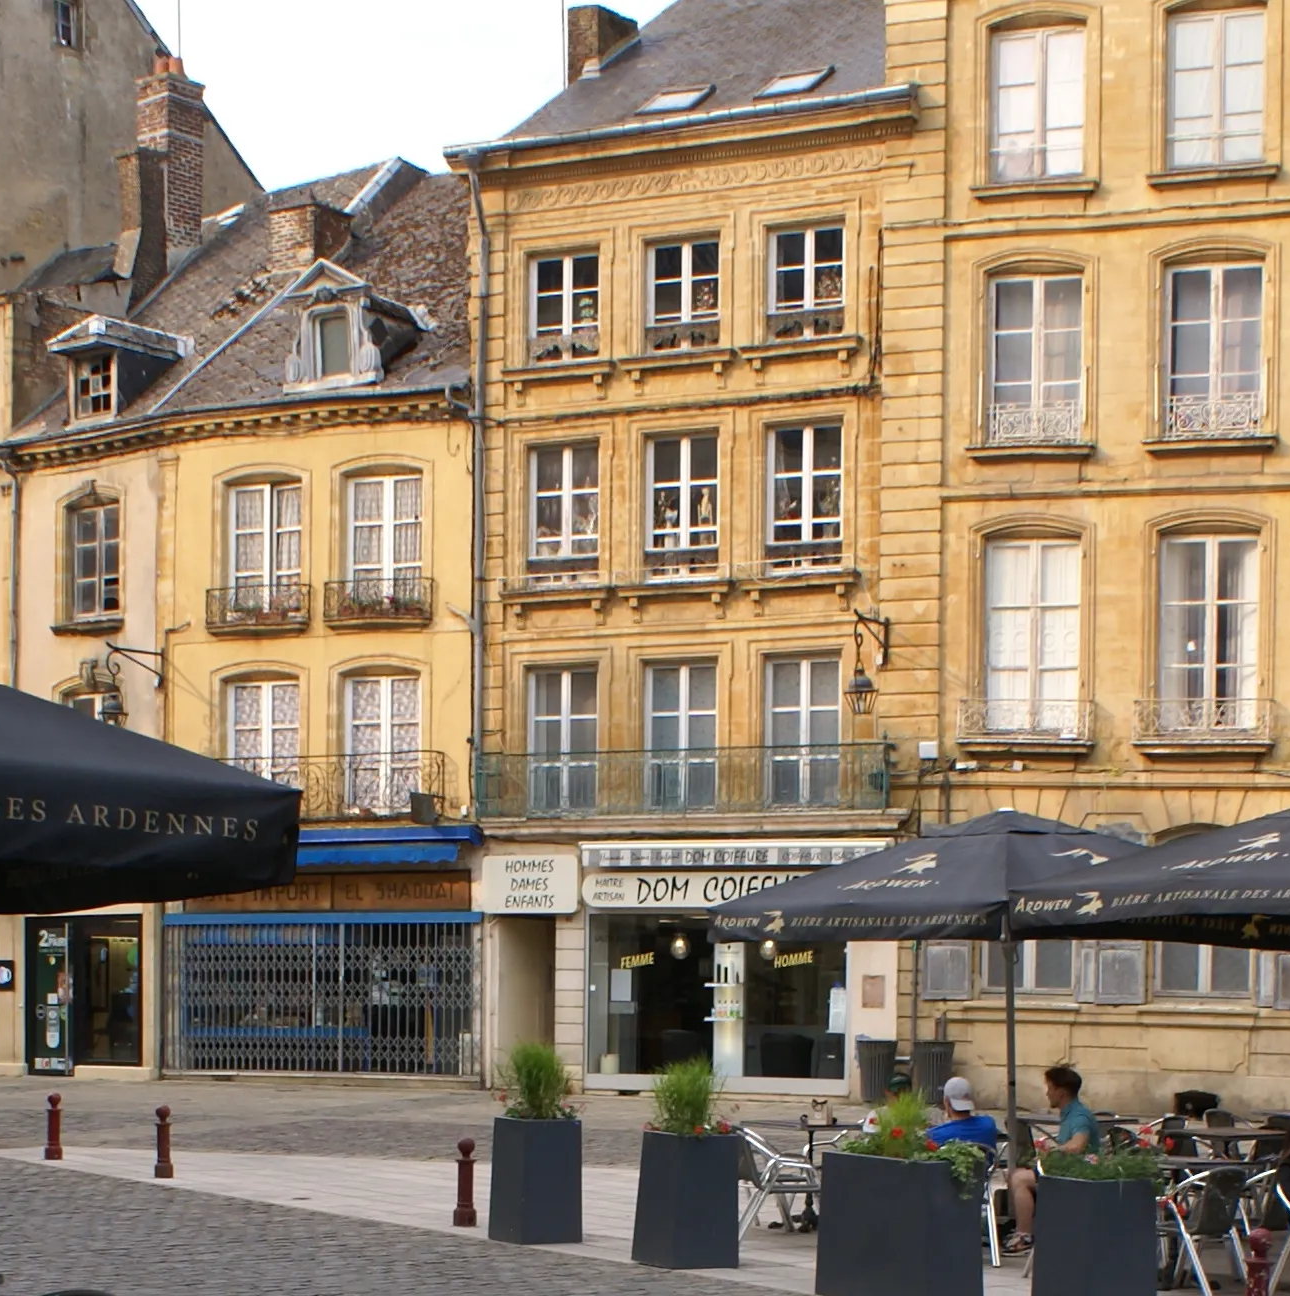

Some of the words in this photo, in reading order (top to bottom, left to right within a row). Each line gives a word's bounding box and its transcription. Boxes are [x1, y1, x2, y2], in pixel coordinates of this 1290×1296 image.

[66, 804, 258, 842] ARDENNES
[685, 850, 710, 863] DOM
[505, 859, 554, 874] HOMMES
[510, 877, 549, 891] DAMES
[636, 876, 690, 904] DOM
[504, 895, 554, 910] ENFANTS
[1153, 889, 1238, 904] ARTISANALE
[1242, 888, 1269, 900] DES
[620, 952, 655, 969] FEMME
[773, 950, 813, 969] HOMME
